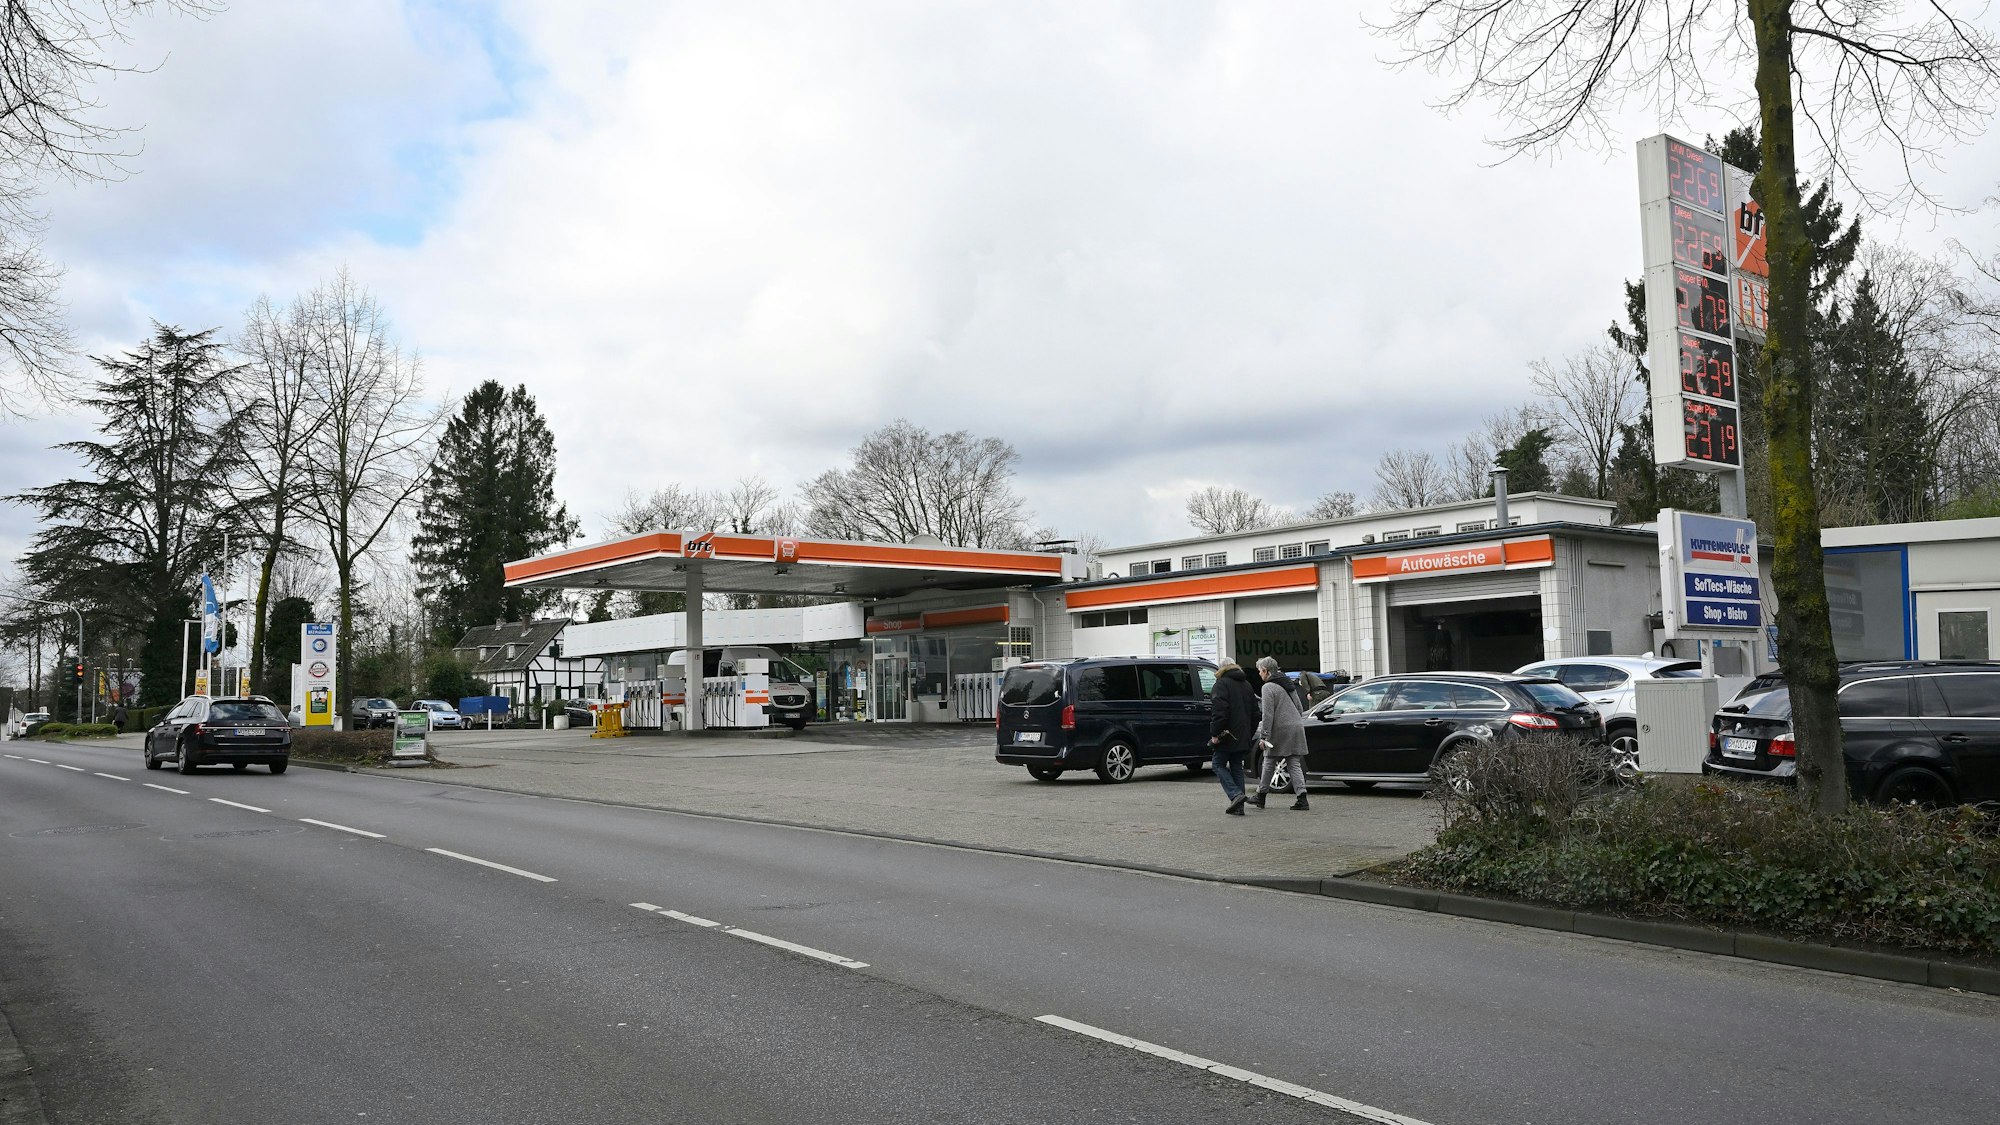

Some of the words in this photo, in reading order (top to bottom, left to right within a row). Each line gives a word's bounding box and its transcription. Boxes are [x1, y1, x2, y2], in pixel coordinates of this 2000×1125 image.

[1686, 148, 1703, 163] Diesel
[1674, 205, 1693, 220] Diesel
[1679, 270, 1696, 285] Super
[1682, 335, 1700, 349] Super
[1687, 402, 1704, 414] Super
[1705, 405, 1718, 416] Plus
[687, 540, 713, 553] bft
[1400, 551, 1486, 572] Autowäsche
[1694, 577, 1753, 595] SofTecs-Wäsche
[1704, 605, 1722, 622] Shop
[1727, 607, 1748, 621] Bistro
[883, 619, 902, 630] Shop
